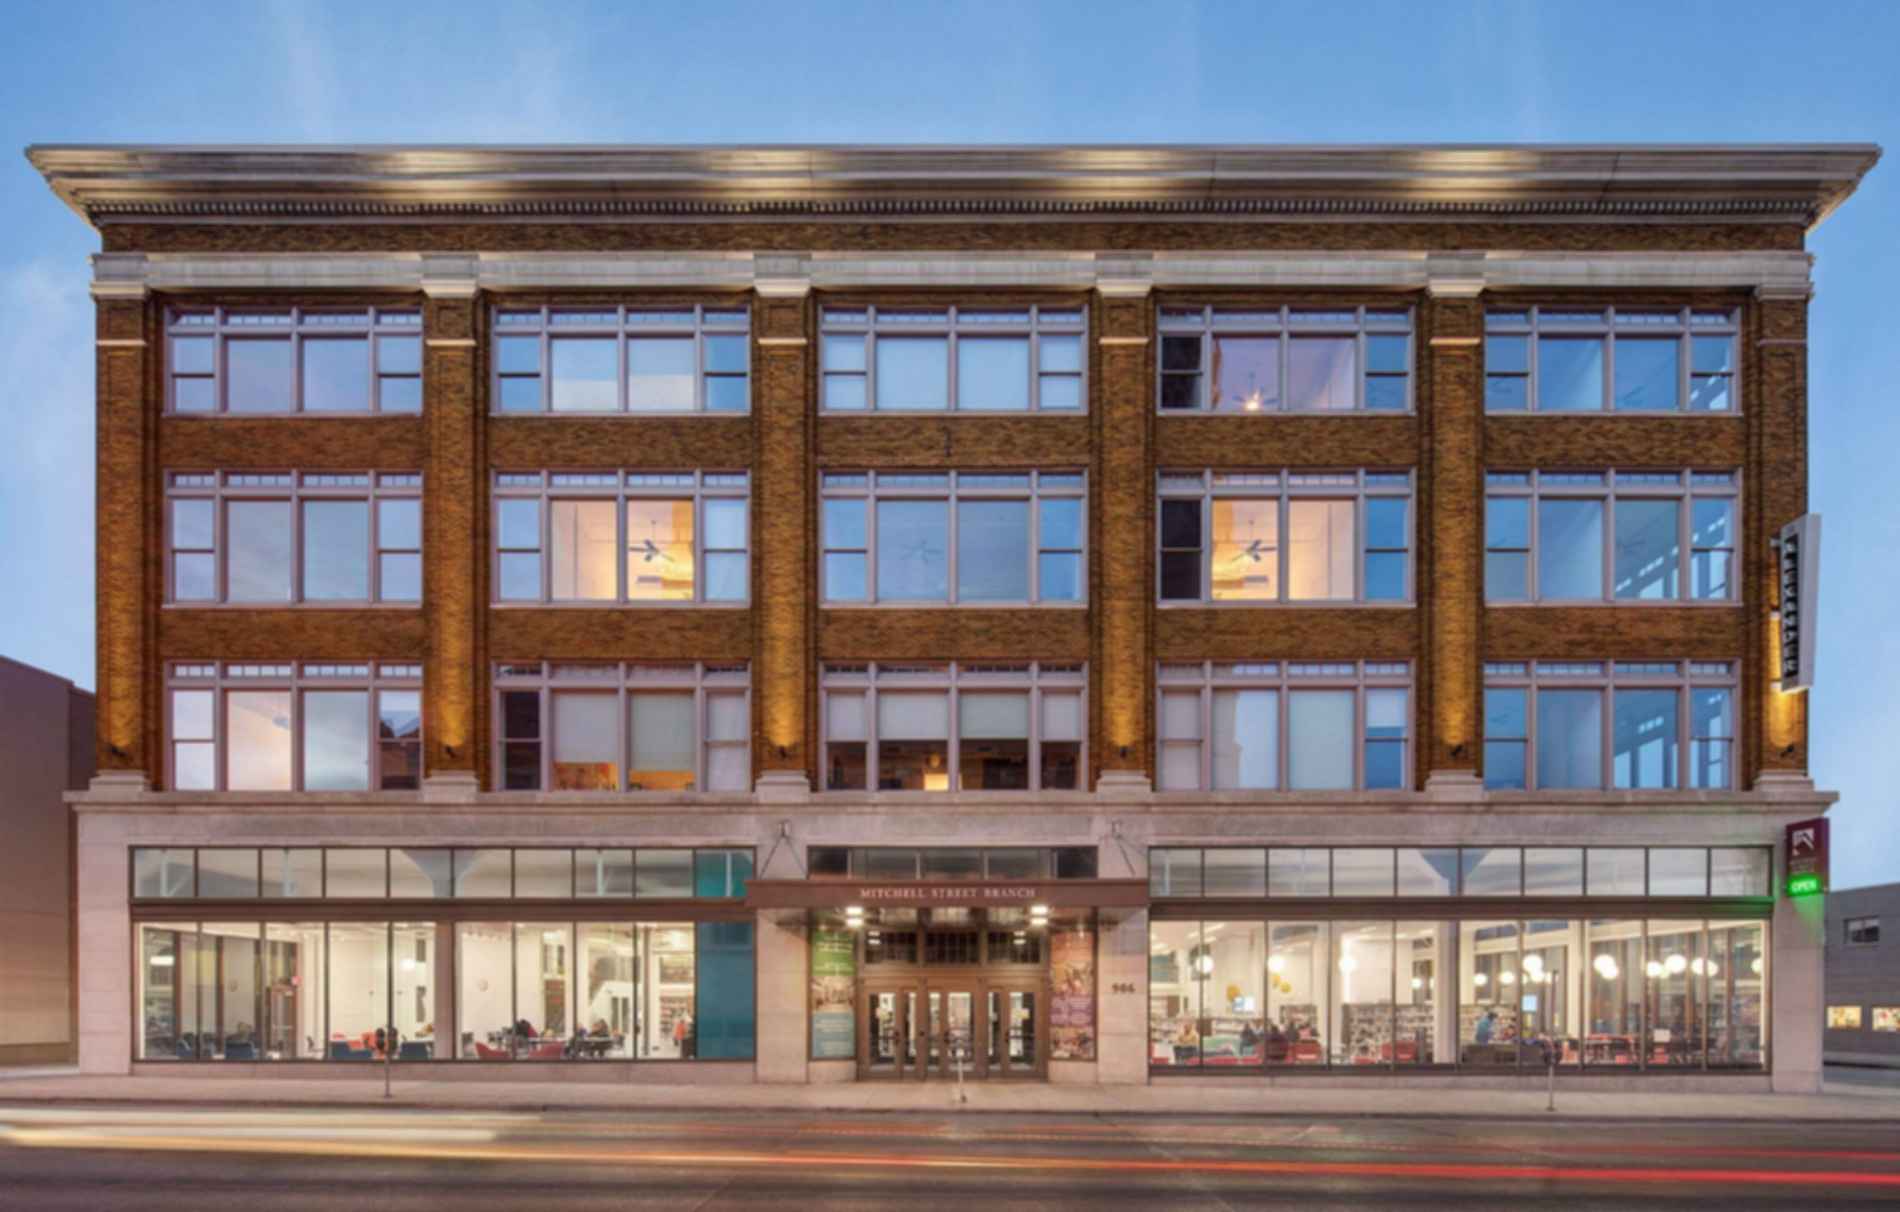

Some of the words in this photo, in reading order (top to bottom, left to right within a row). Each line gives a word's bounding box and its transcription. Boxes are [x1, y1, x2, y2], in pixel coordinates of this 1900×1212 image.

[1791, 880, 1817, 893] OPEN
[860, 887, 925, 899] MITCHELL
[931, 887, 977, 899] STREET
[984, 887, 1036, 899] BRANCH
